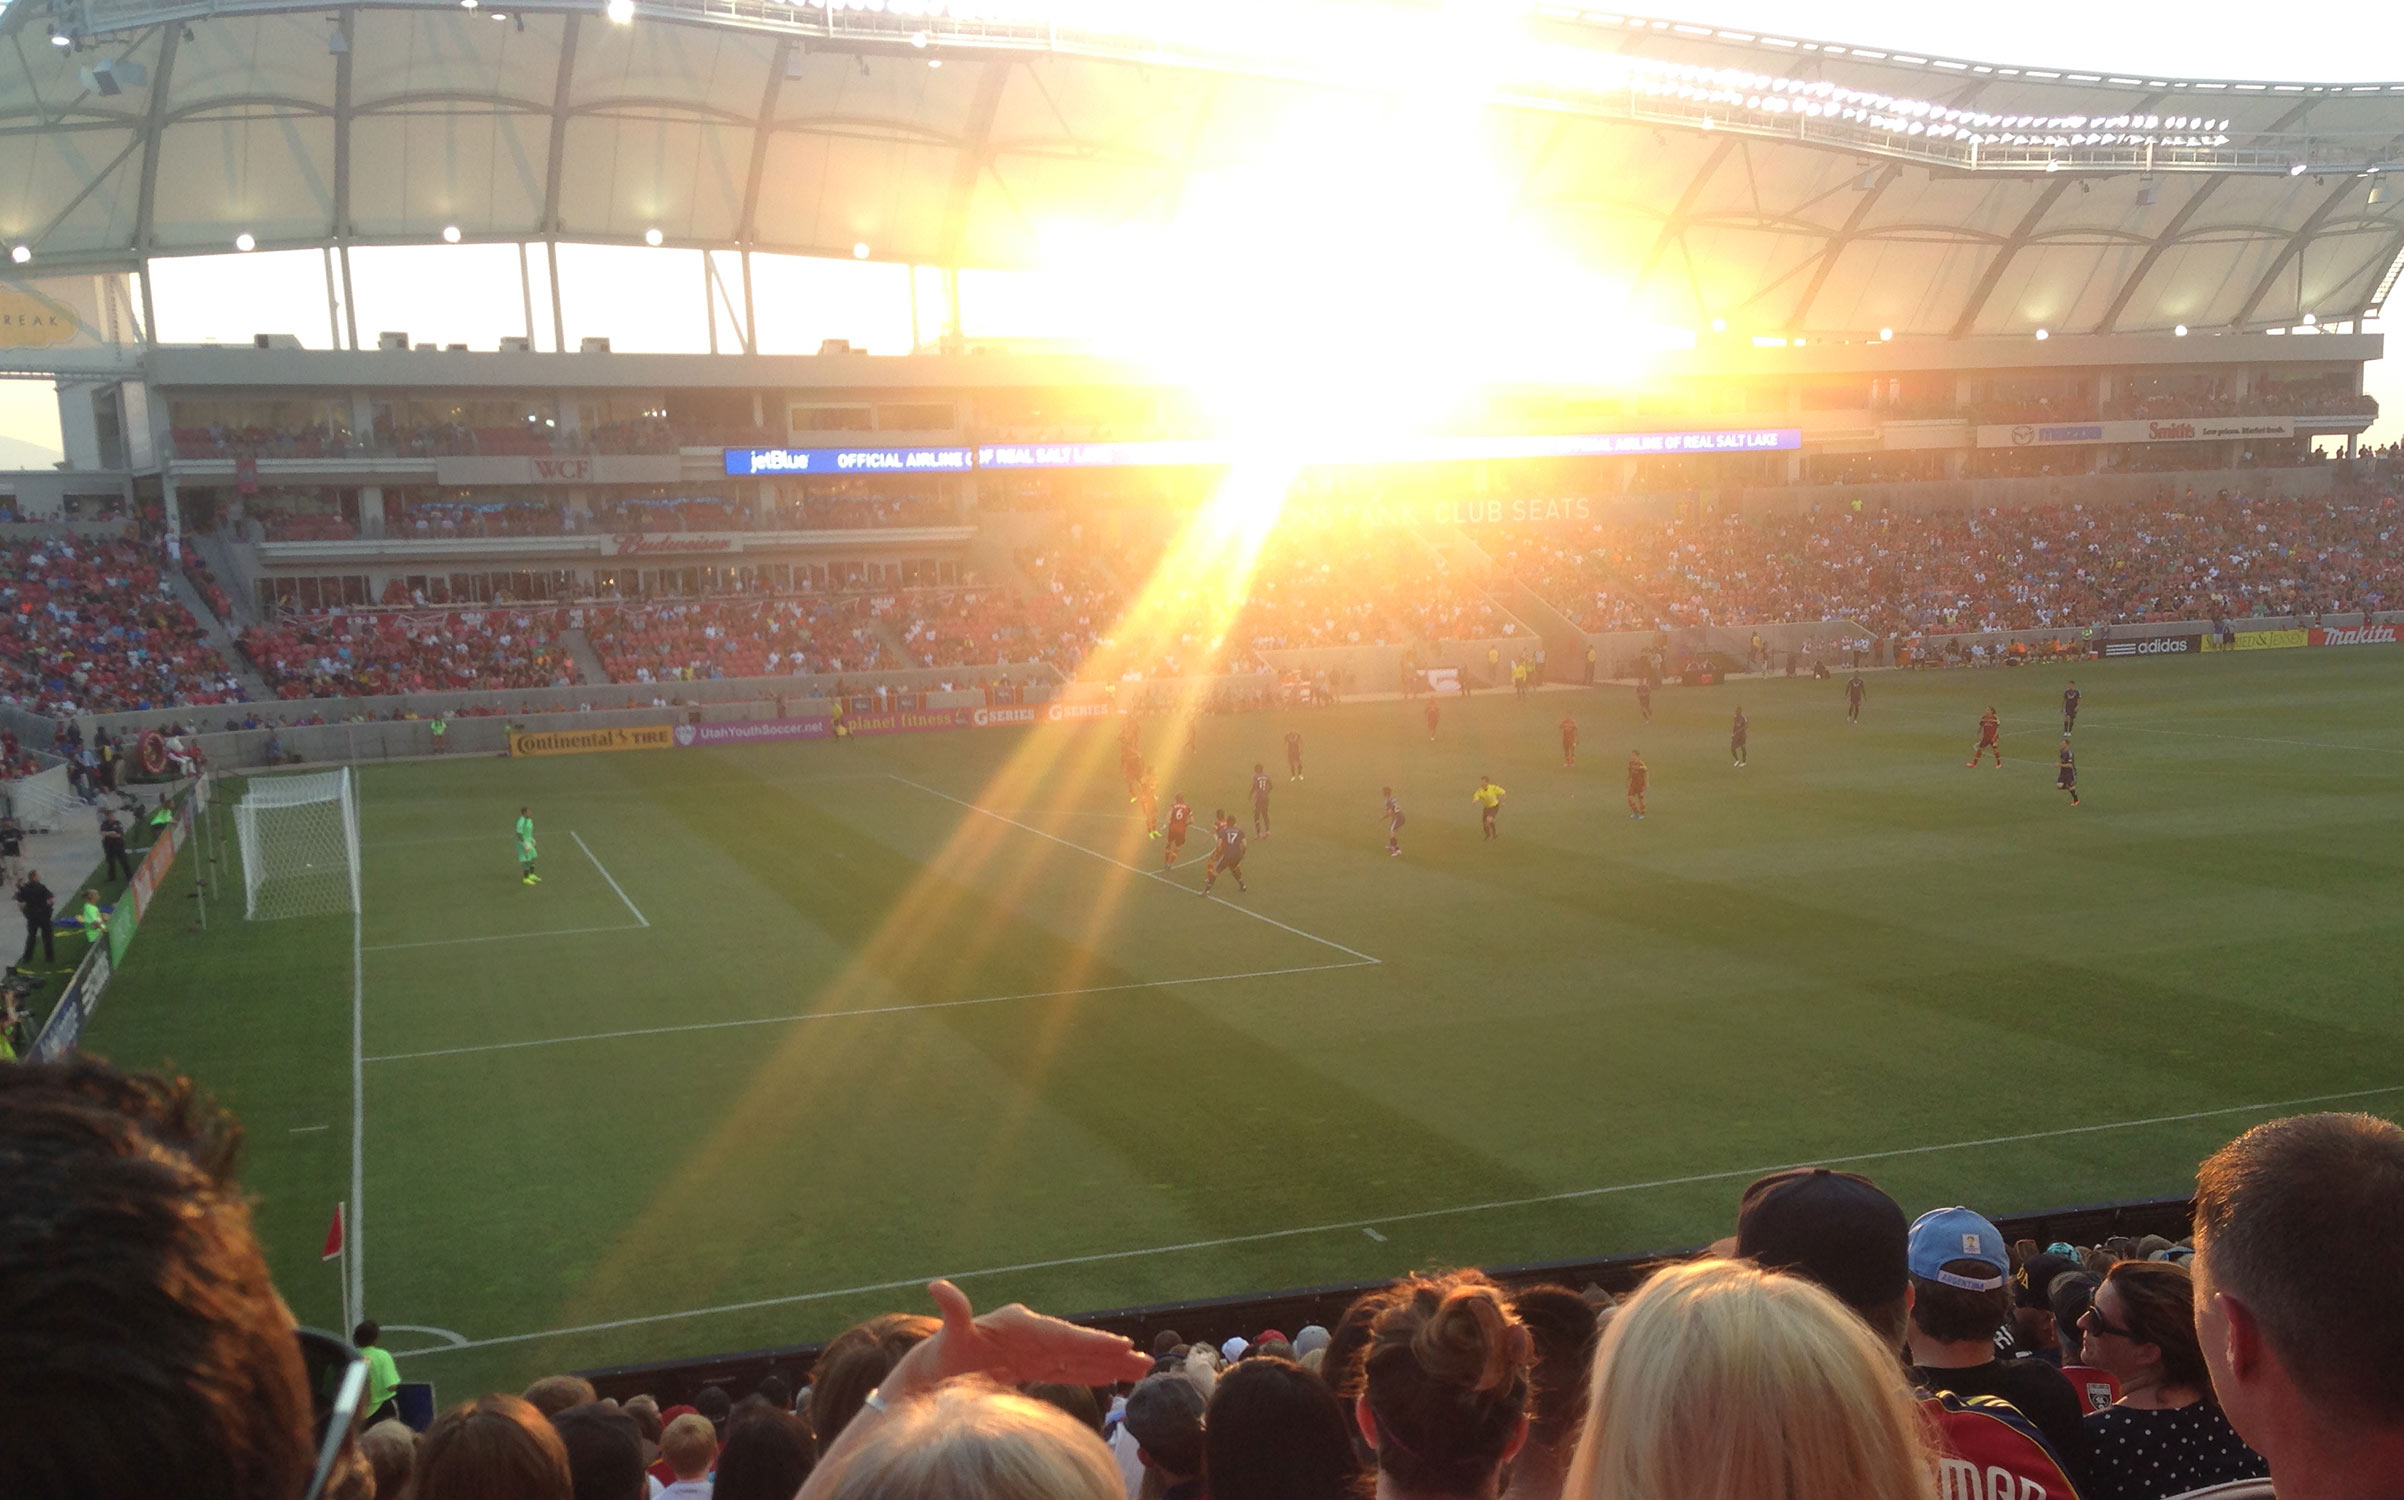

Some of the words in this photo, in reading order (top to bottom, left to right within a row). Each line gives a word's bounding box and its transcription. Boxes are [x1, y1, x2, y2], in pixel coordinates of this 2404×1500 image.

[3, 314, 58, 326] REAK
[1684, 435, 1714, 448] REAL
[1716, 434, 1745, 447] SALT
[1747, 433, 1778, 446] LAKE
[534, 459, 589, 480] WCF
[750, 450, 809, 474] jetBlue
[837, 453, 904, 469] OFFICIAL
[1434, 500, 1503, 525] CLUB
[1512, 497, 1590, 522] SEATS
[2138, 637, 2188, 655] adidas
[989, 708, 1035, 724] SERIES
[700, 720, 824, 739] UtahYouthSoccer.net
[515, 727, 614, 754] Continental
[631, 729, 669, 746] TIRE
[1941, 1273, 1985, 1290] ARGENTINA
